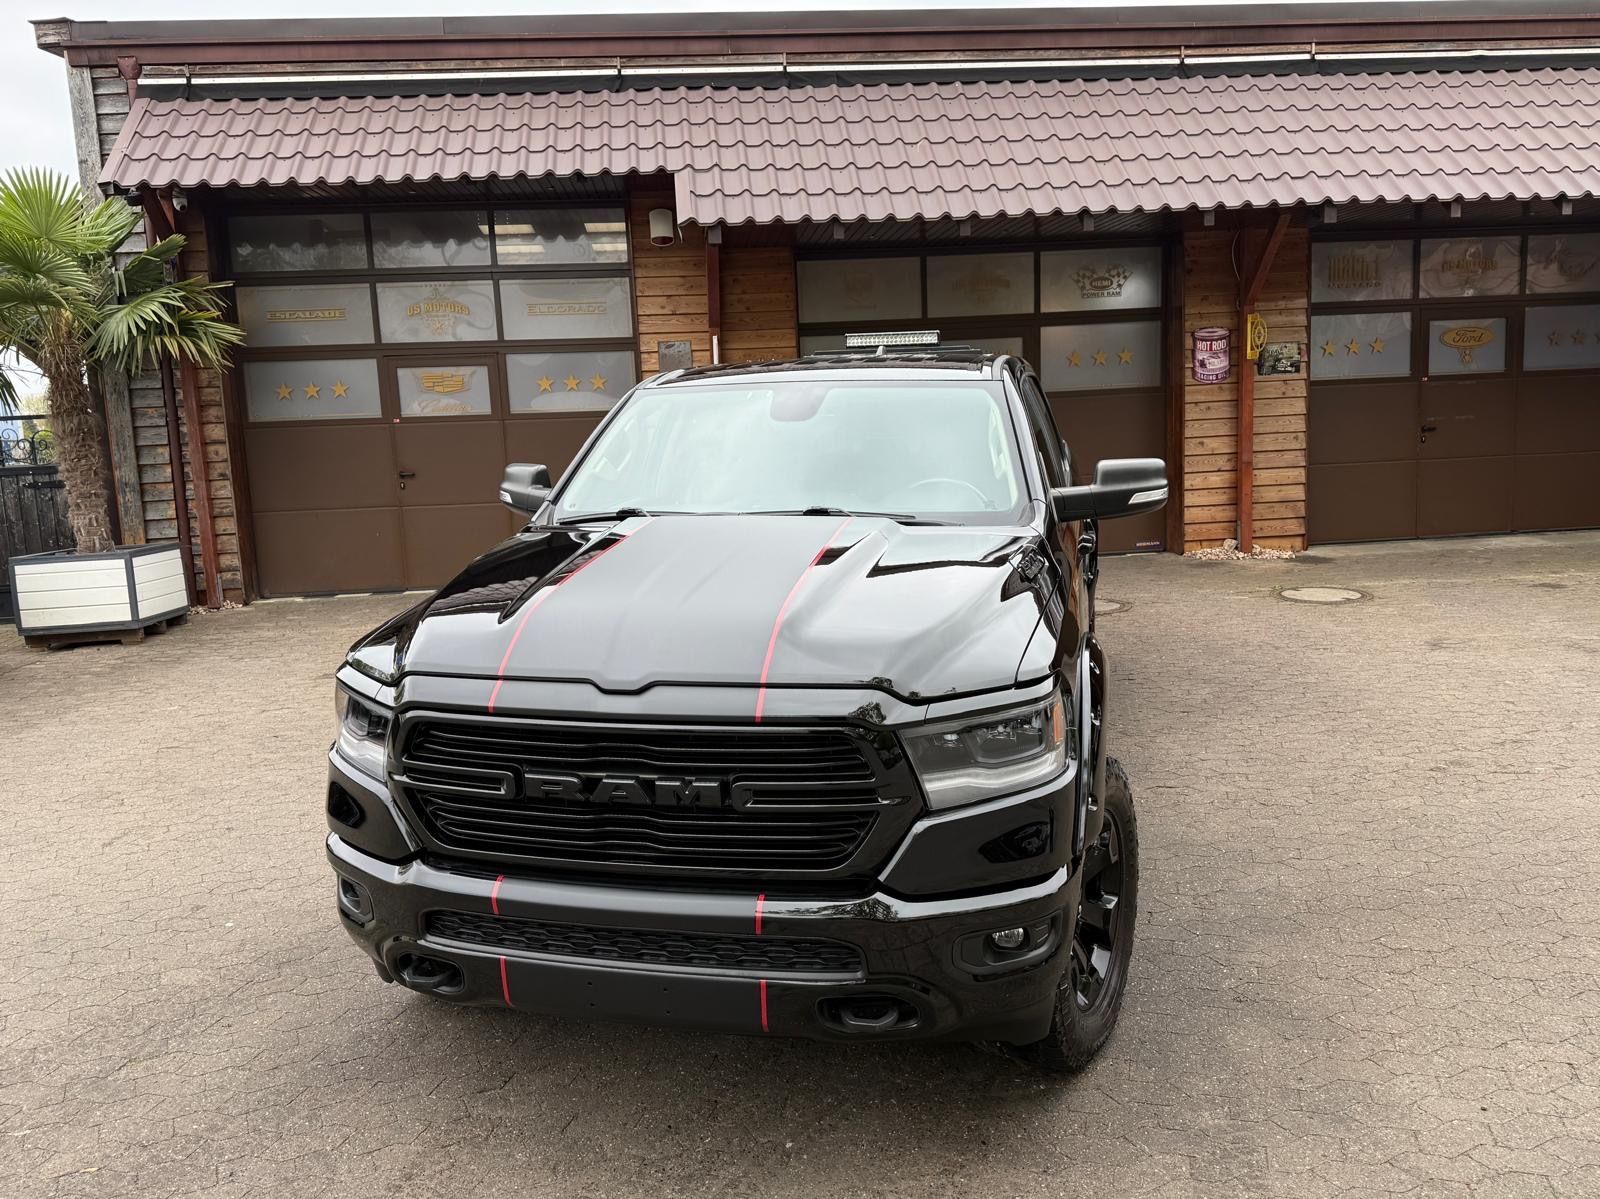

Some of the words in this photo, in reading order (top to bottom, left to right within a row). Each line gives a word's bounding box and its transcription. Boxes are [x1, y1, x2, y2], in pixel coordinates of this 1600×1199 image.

[406, 303, 422, 318] US
[526, 302, 608, 315] ELDORADO
[1452, 329, 1485, 344] Ford
[1197, 341, 1211, 351] HOT
[1212, 340, 1227, 350] ROD
[525, 773, 722, 809] RAM
